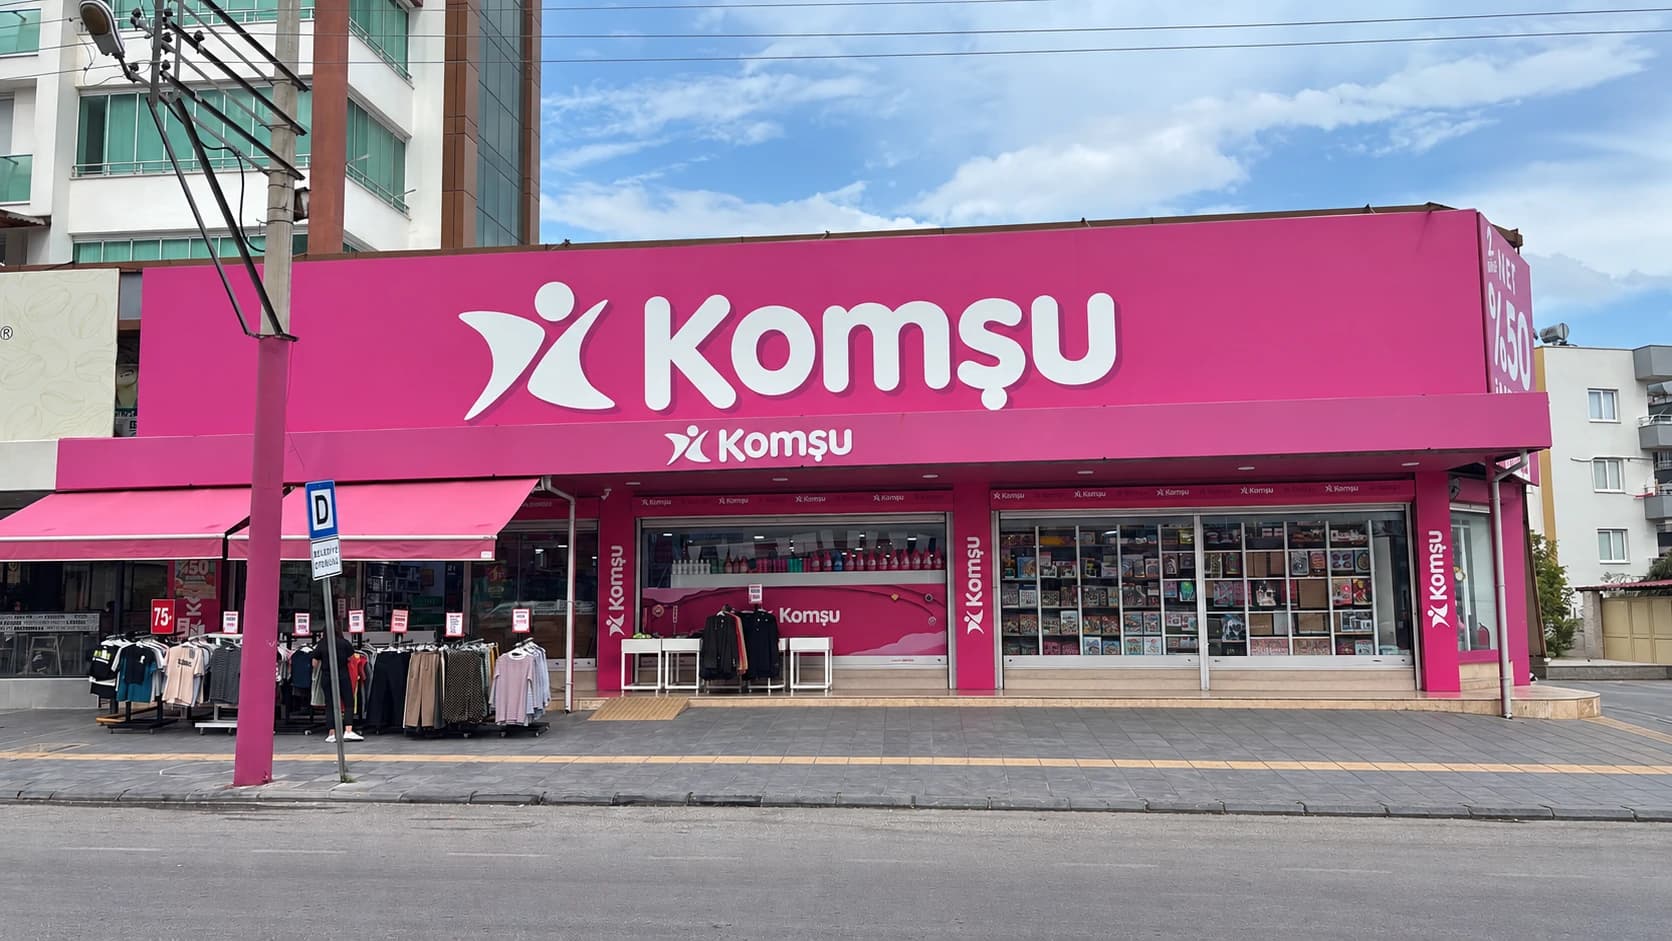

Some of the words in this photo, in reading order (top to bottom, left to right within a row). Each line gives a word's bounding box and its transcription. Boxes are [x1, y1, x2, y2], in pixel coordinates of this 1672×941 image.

[644, 292, 1117, 411] Komşu
[1487, 281, 1531, 391] %50
[717, 427, 854, 463] Komşu
[314, 494, 329, 525] D
[608, 545, 626, 611] Komşu
[965, 536, 984, 607] Komşu
[1428, 530, 1448, 600] Komşu
[779, 607, 840, 626] Komşu
